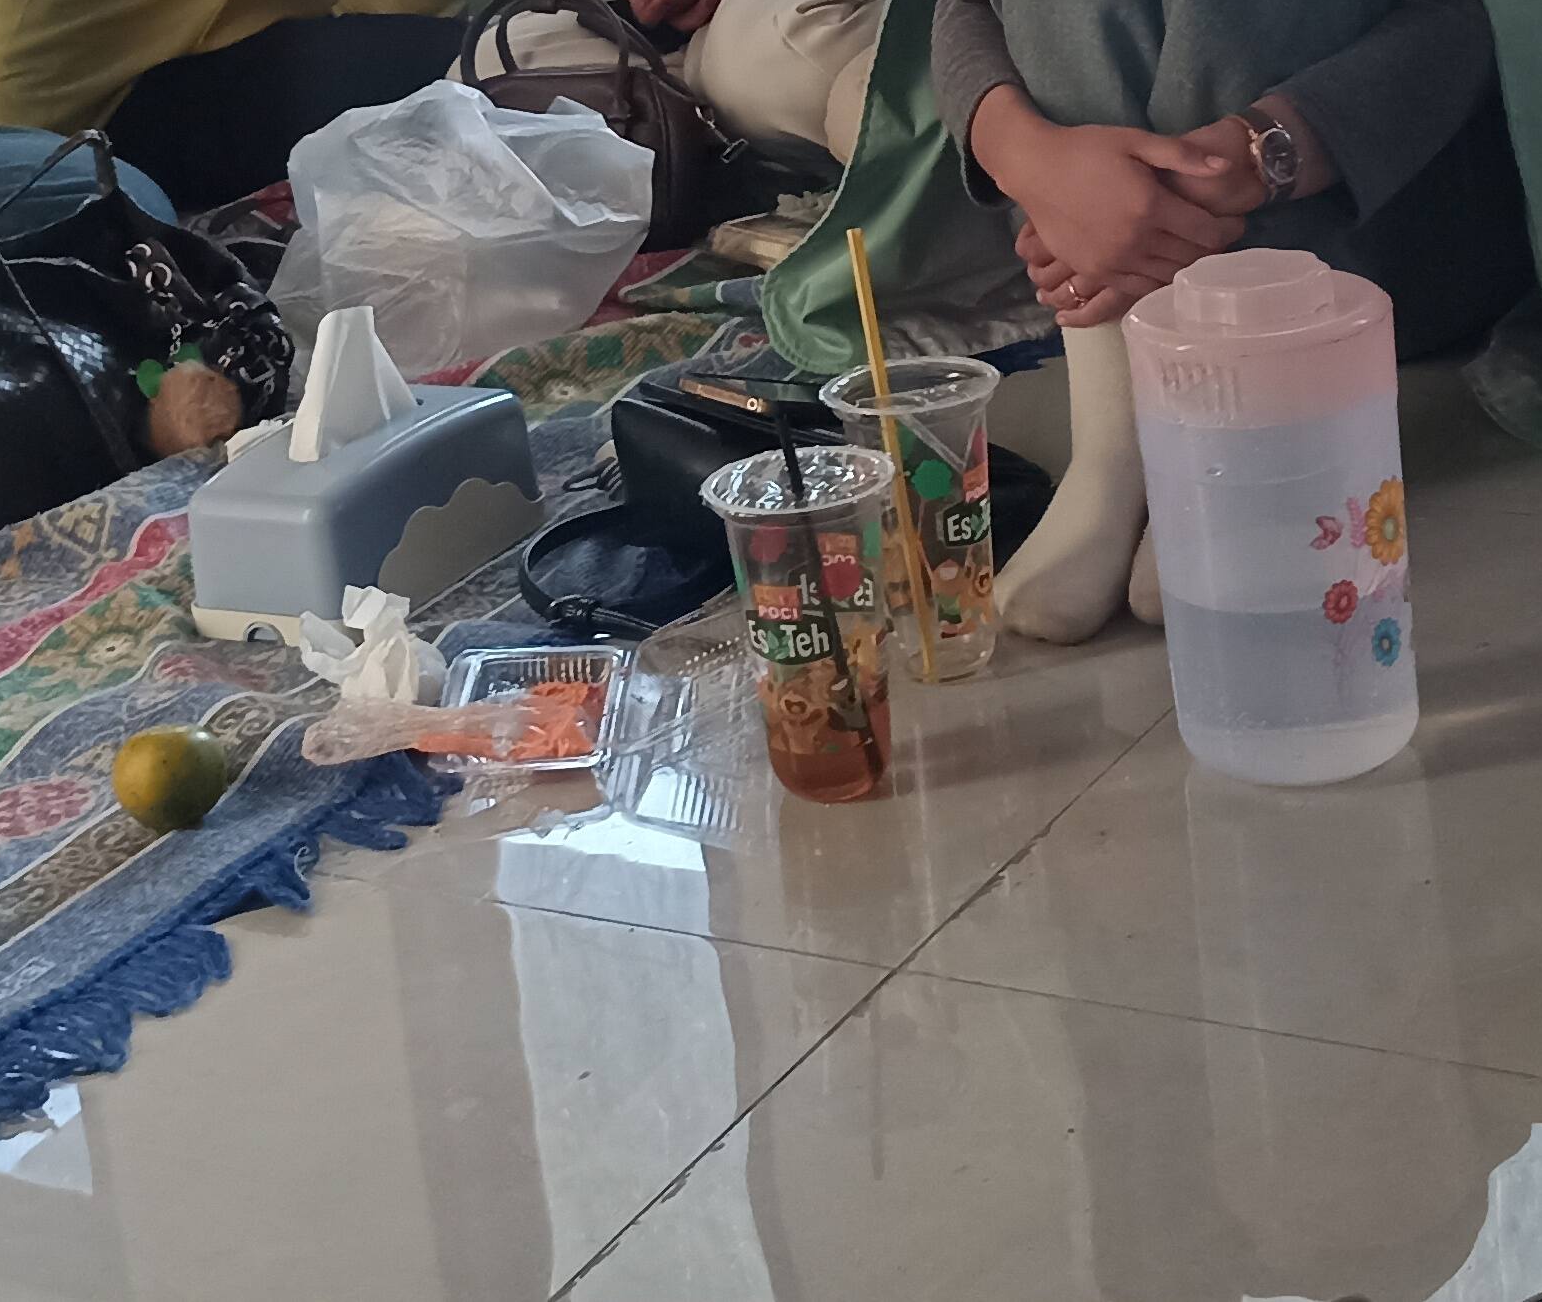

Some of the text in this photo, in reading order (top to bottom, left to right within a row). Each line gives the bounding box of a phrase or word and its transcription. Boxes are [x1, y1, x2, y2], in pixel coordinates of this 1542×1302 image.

[947, 514, 972, 542] Es
[758, 604, 799, 620] POCI
[748, 619, 830, 658] Es Teh
